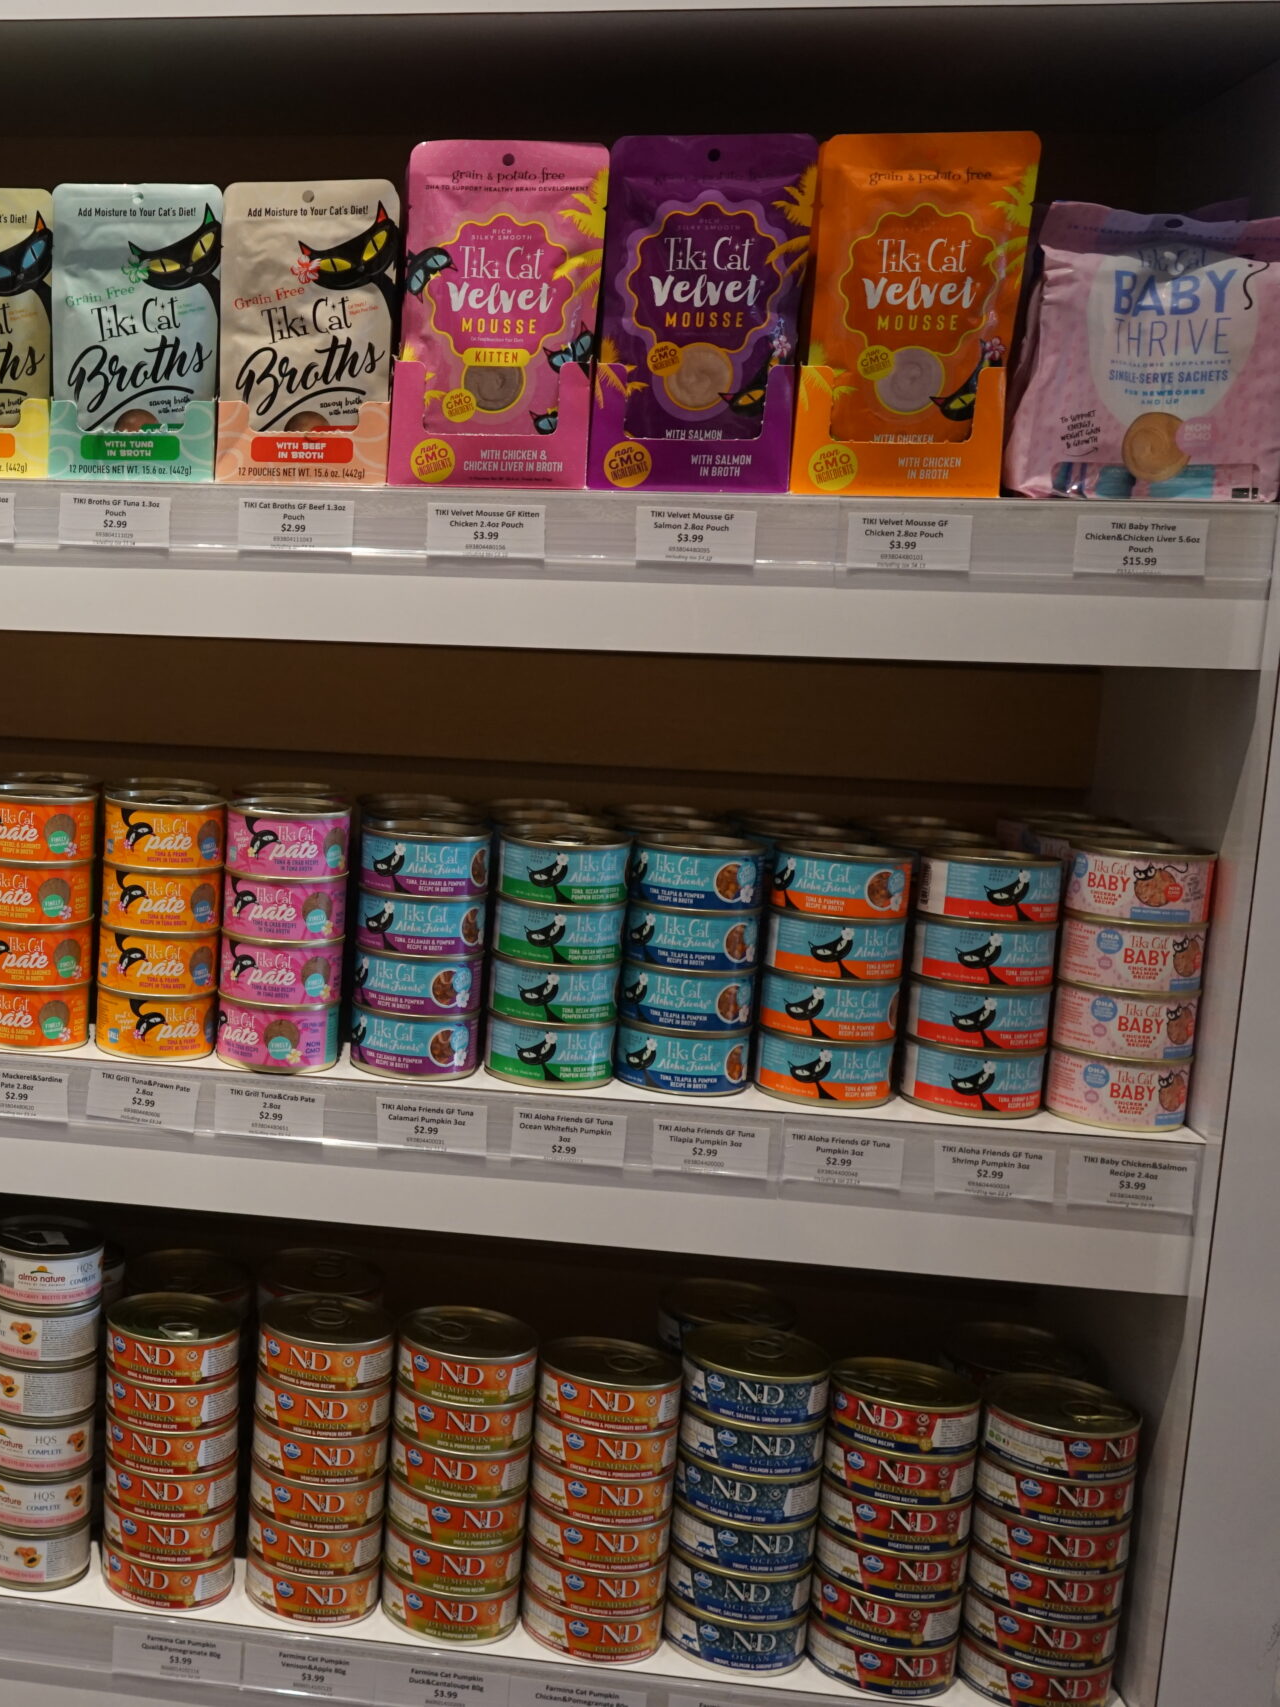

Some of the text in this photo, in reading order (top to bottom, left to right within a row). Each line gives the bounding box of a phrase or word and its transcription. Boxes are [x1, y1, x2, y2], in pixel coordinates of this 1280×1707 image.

[452, 169, 483, 184] grain
[497, 169, 537, 184] potato
[539, 168, 565, 183] free
[10, 214, 28, 224] Diet!
[460, 245, 544, 280] Tiki Cat
[446, 281, 556, 314] Velvet
[650, 274, 761, 308] Velvet
[862, 276, 977, 310] Velvet
[1114, 269, 1237, 317] BABY
[261, 297, 352, 345] Tiki Cat
[461, 317, 537, 335] MOUSSE
[1115, 318, 1232, 357] THRIVE
[475, 351, 519, 363] KITTEN
[68, 336, 212, 413] Broths
[235, 335, 385, 415] Broths
[1178, 370, 1228, 382] SACHETS
[415, 447, 448, 465] GMO
[480, 450, 547, 460] WITH CHICKEN &
[715, 454, 751, 465] SALMON
[6, 463, 27, 473] (442g)
[464, 460, 563, 472] CHICKEN LIVER IN BROTH
[667, 511, 690, 519] Velvet
[692, 512, 721, 520] Mousse
[103, 520, 127, 529] $2.99
[1128, 522, 1177, 532] Baby Thrive
[677, 533, 704, 543] $3.99
[1122, 556, 1157, 567] $15.99
[414, 845, 457, 864] Tiki Cat
[1087, 873, 1130, 891] BABY
[381, 1103, 395, 1111] TIKI
[396, 1104, 415, 1113] Aloha
[416, 1105, 444, 1115] Friends
[456, 1109, 474, 1117] Tuna
[519, 1122, 612, 1137] Ocean Whitefish Pumpkin
[977, 1168, 1004, 1180] $2.99
[1110, 1168, 1159, 1181] Recipe 2.4oz
[878, 1439, 895, 1448] RECIPE
[28, 1448, 62, 1456] COMPLETE
[169, 1656, 192, 1666] $3.99
[279, 1651, 305, 1660] Farmina
[320, 1656, 350, 1667] Pumpkin
[301, 1672, 325, 1682] $3.99
